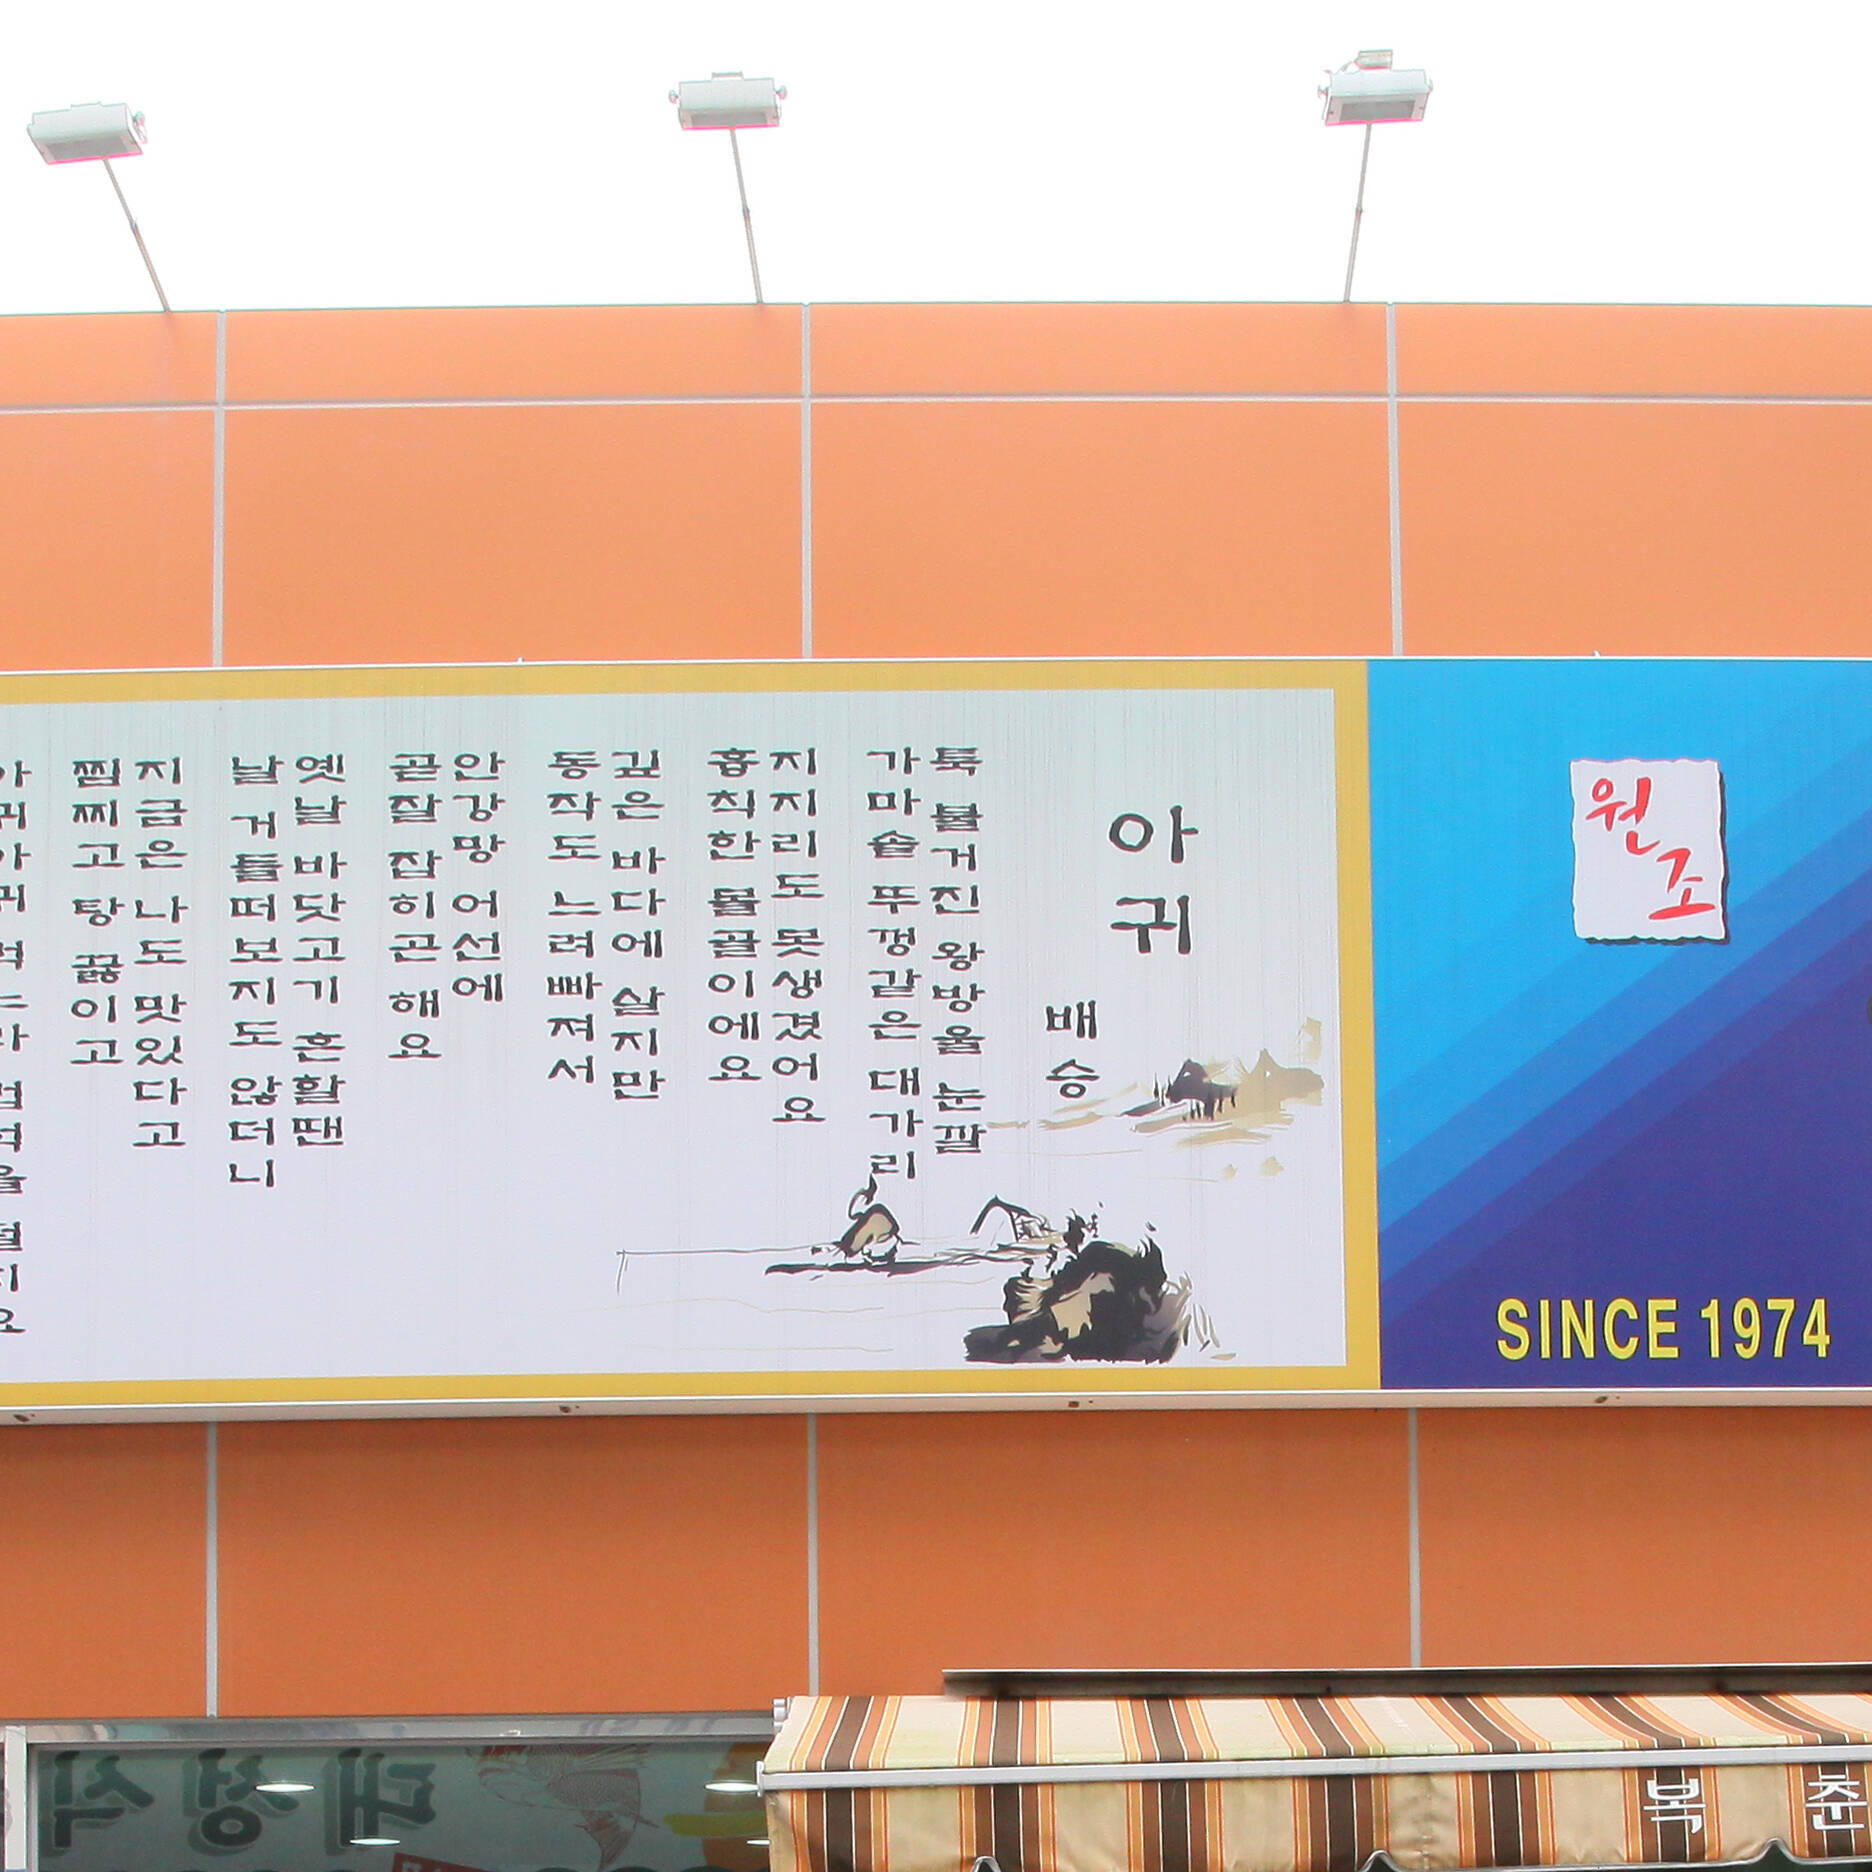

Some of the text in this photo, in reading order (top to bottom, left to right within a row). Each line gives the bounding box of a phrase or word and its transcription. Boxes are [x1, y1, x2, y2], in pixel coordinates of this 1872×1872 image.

[452, 752, 505, 1002] 안강망 어선에
[867, 747, 921, 858] 가마솥
[1585, 776, 1716, 920] 원조
[72, 897, 124, 926] 탕
[133, 757, 188, 1147] 지금은 나도 맛있다고
[292, 754, 347, 1146] 옛날 바닷고기 흔할땐
[388, 850, 442, 962] 잡히곤
[547, 751, 602, 1083] 동작도 느려빠져서
[611, 750, 666, 1099] 깊은 바다에 살지만
[707, 748, 761, 1081] 흉칙한 몰골이에요
[769, 748, 825, 1122] 지지리도 못생겼어요
[930, 747, 987, 1154] 툭 불거진 왕방울 눈깔
[1109, 805, 1199, 954] 아귀
[71, 954, 122, 1064] 끓이고
[228, 755, 284, 1187] 날 거들떠보지도 않더니
[388, 989, 441, 1058] 해요
[1046, 1000, 1099, 1098] 배승
[868, 1067, 924, 1183] 대가리
[1495, 1297, 1831, 1360] SINCE 1974
